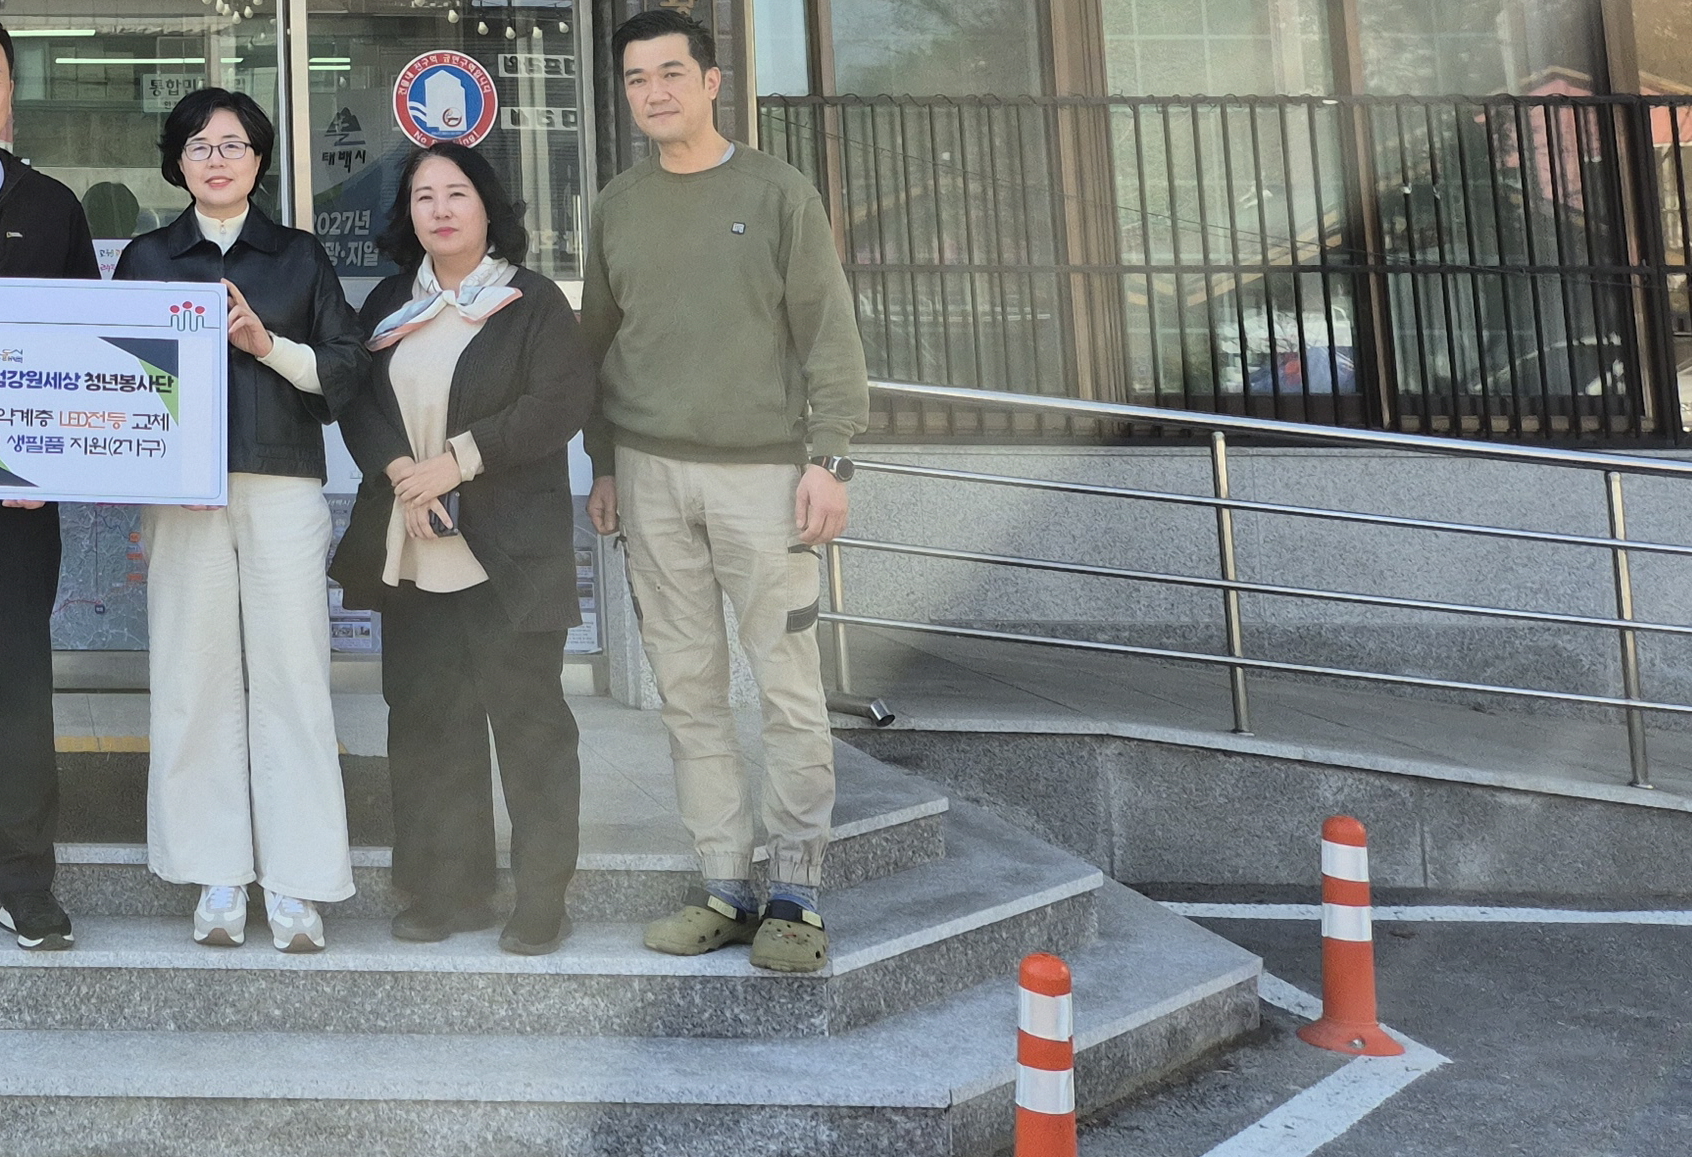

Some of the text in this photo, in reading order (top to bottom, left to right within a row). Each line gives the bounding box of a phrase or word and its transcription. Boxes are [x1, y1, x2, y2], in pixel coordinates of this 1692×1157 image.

[413, 130, 427, 144] No
[322, 149, 366, 173] 태백시
[315, 209, 371, 236] 027년
[84, 372, 174, 393] 청년봉사단
[59, 410, 127, 430] LED전등
[7, 434, 65, 454] 생필품
[70, 436, 166, 458] 지원(2가구)
